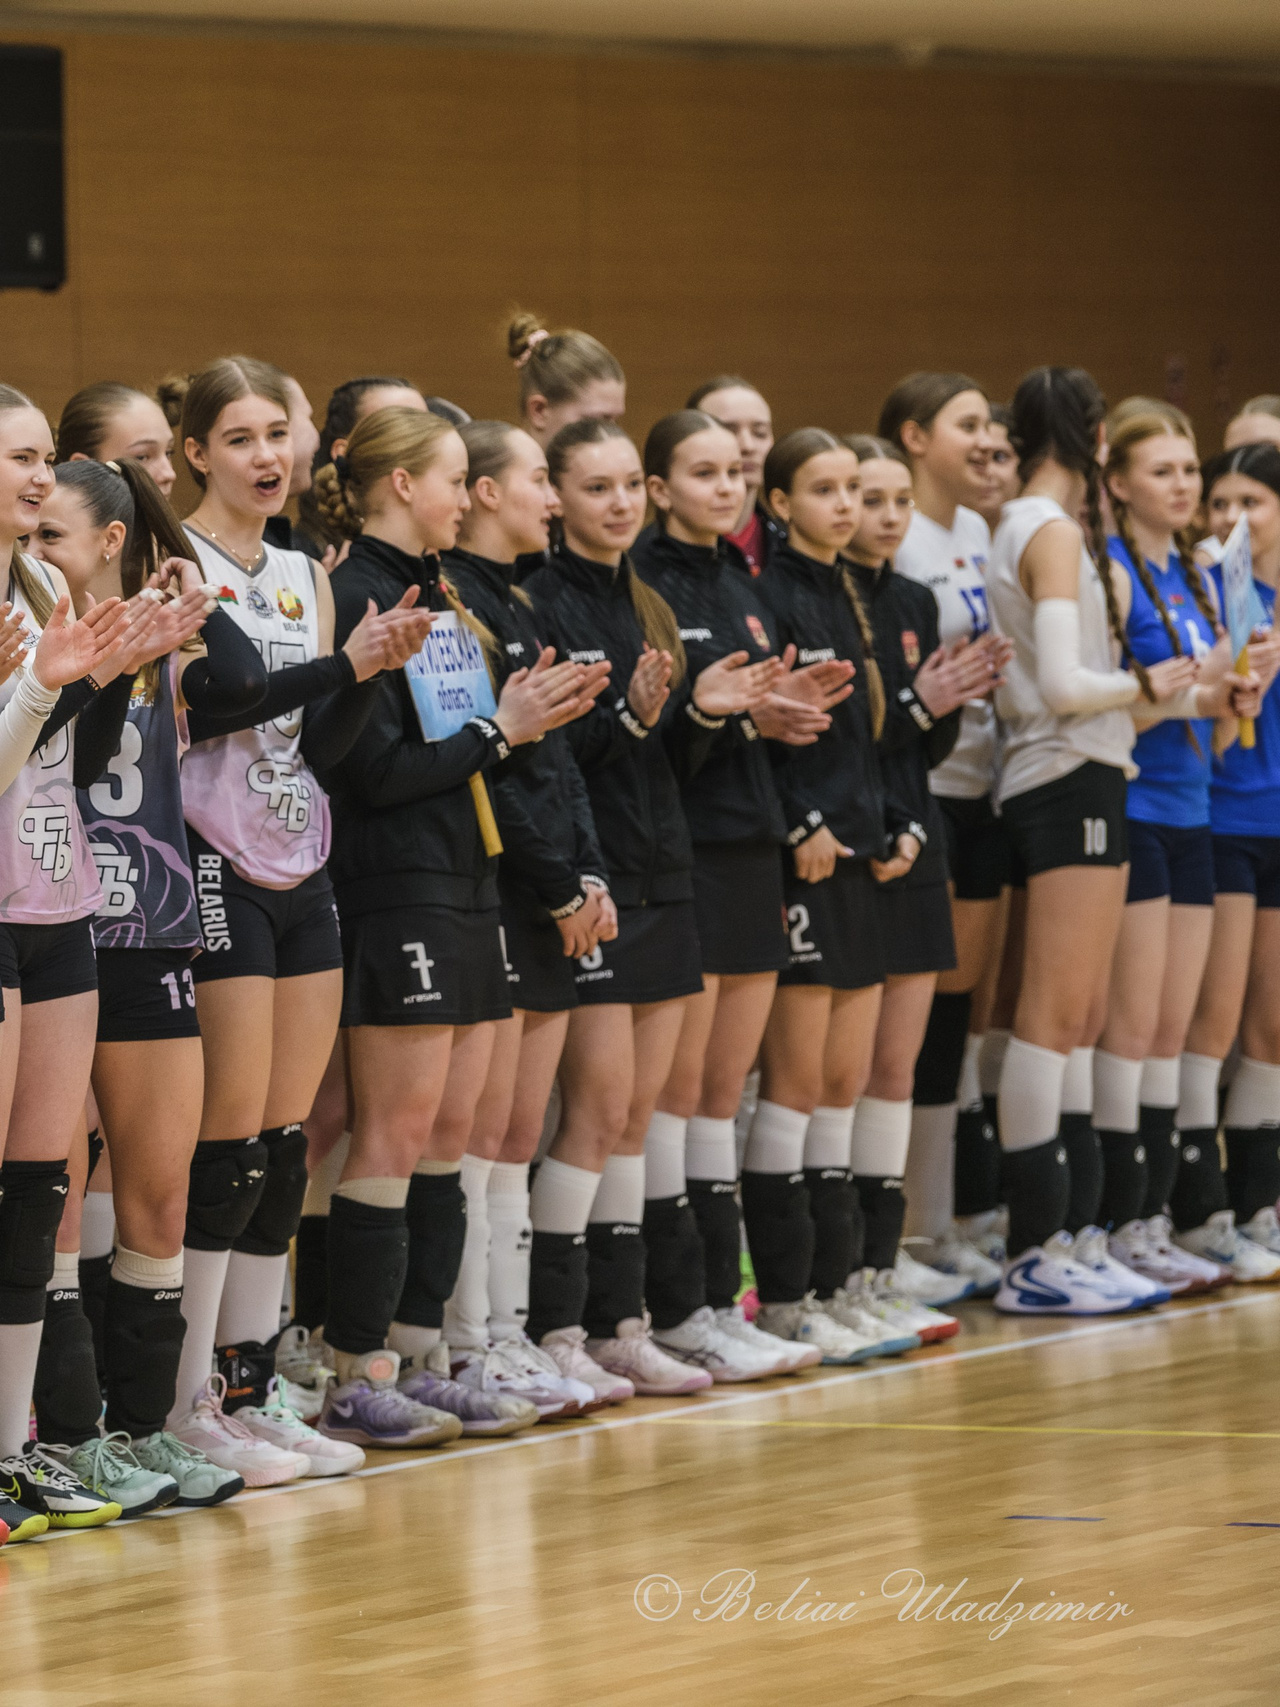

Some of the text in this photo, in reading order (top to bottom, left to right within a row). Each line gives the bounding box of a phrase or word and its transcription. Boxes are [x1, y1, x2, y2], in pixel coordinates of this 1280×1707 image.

[676, 627, 712, 642] empa
[569, 648, 606, 664] empa
[1082, 817, 1108, 856] 10
[197, 854, 232, 953] BELARUS
[788, 904, 816, 953] 2
[402, 941, 435, 990] 7
[160, 968, 196, 1010] 13
